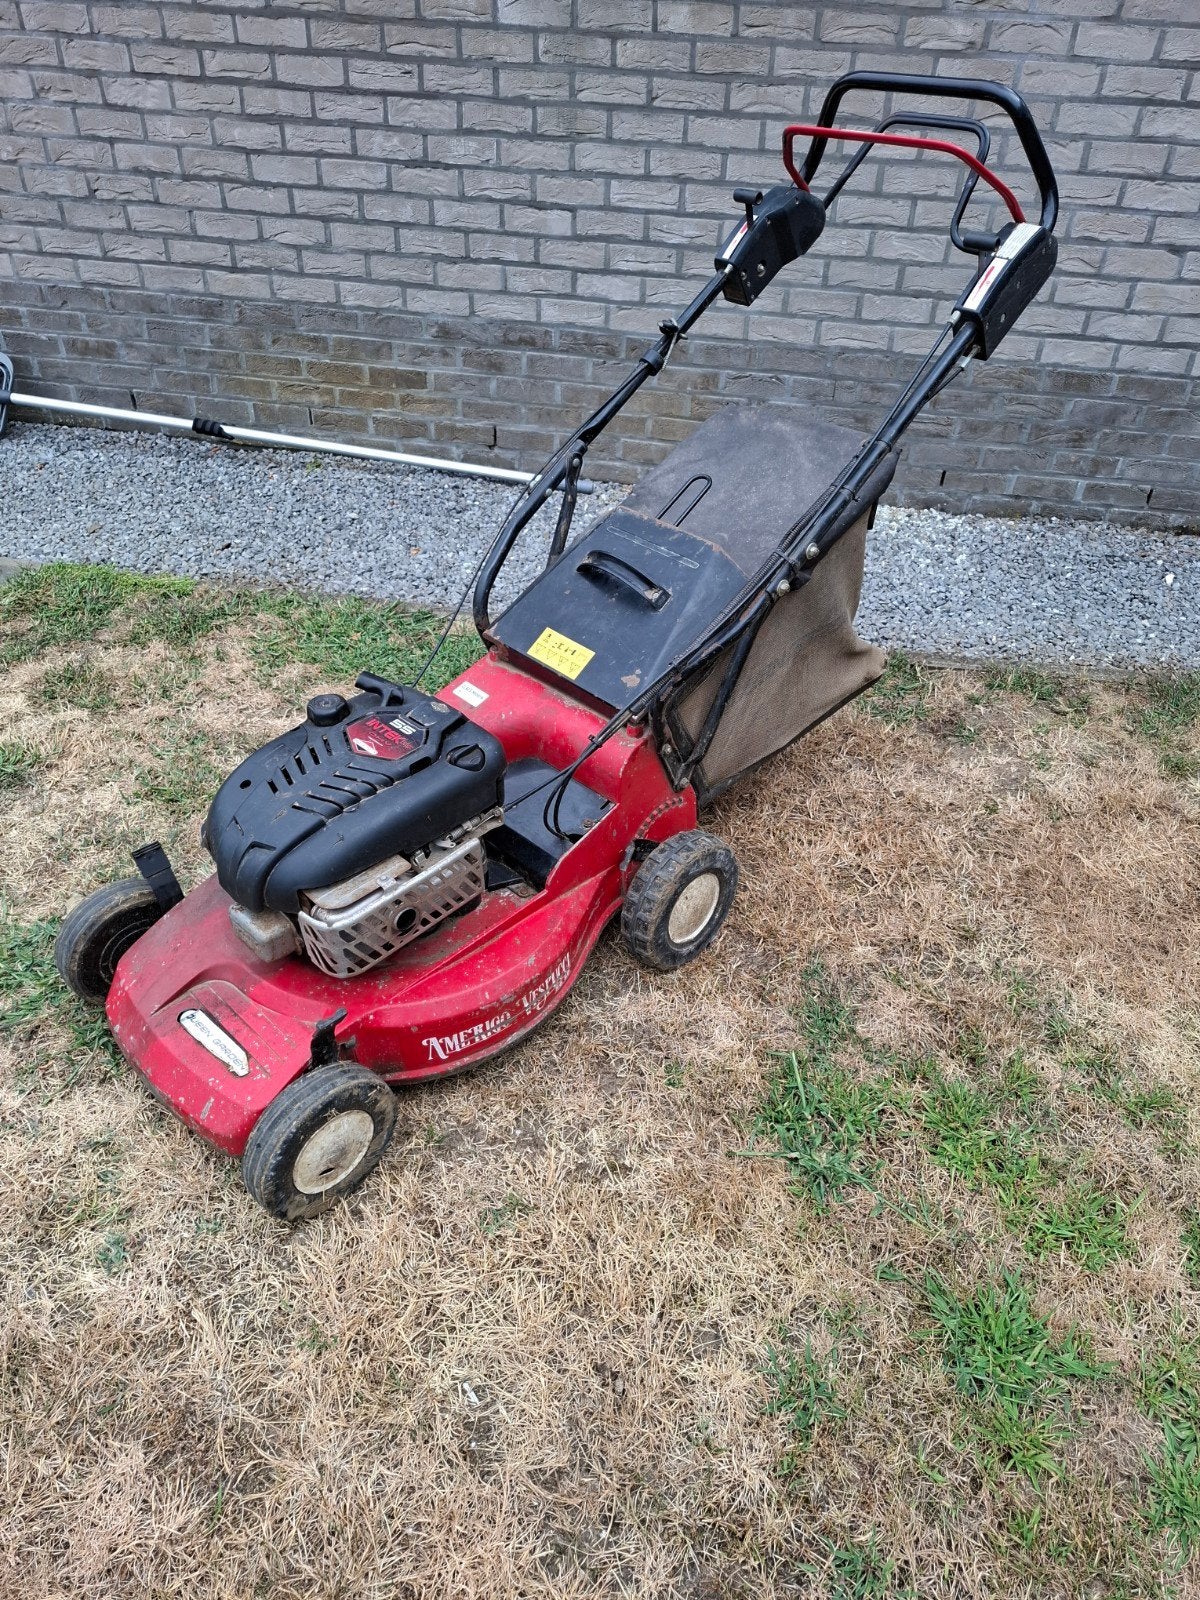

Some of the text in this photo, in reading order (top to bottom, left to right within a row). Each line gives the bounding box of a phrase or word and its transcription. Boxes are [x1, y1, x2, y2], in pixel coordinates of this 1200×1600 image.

[365, 718, 405, 746] INTEK
[183, 1011, 246, 1071] QUEEN GARDEN
